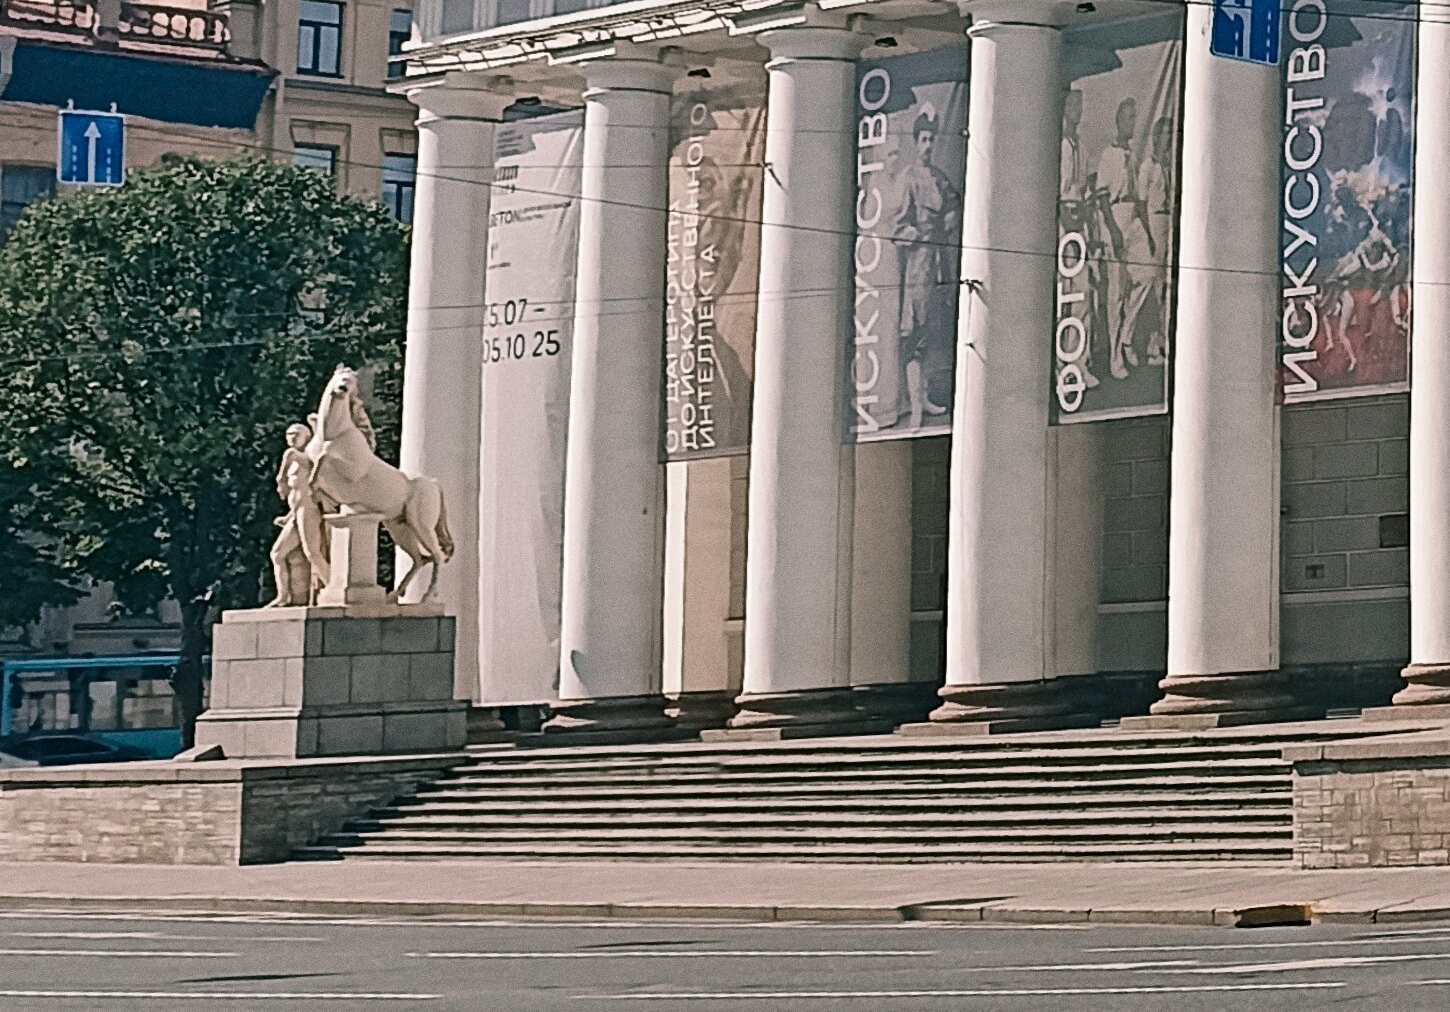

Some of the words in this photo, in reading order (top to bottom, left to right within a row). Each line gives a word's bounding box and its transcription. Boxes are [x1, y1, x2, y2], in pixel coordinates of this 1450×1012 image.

[697, 243, 716, 448] ИНТЕЛЛЕКТА
[850, 68, 891, 433] ИСКУССТВО
[1055, 231, 1088, 413] ФОТО
[681, 403, 699, 450] ДО
